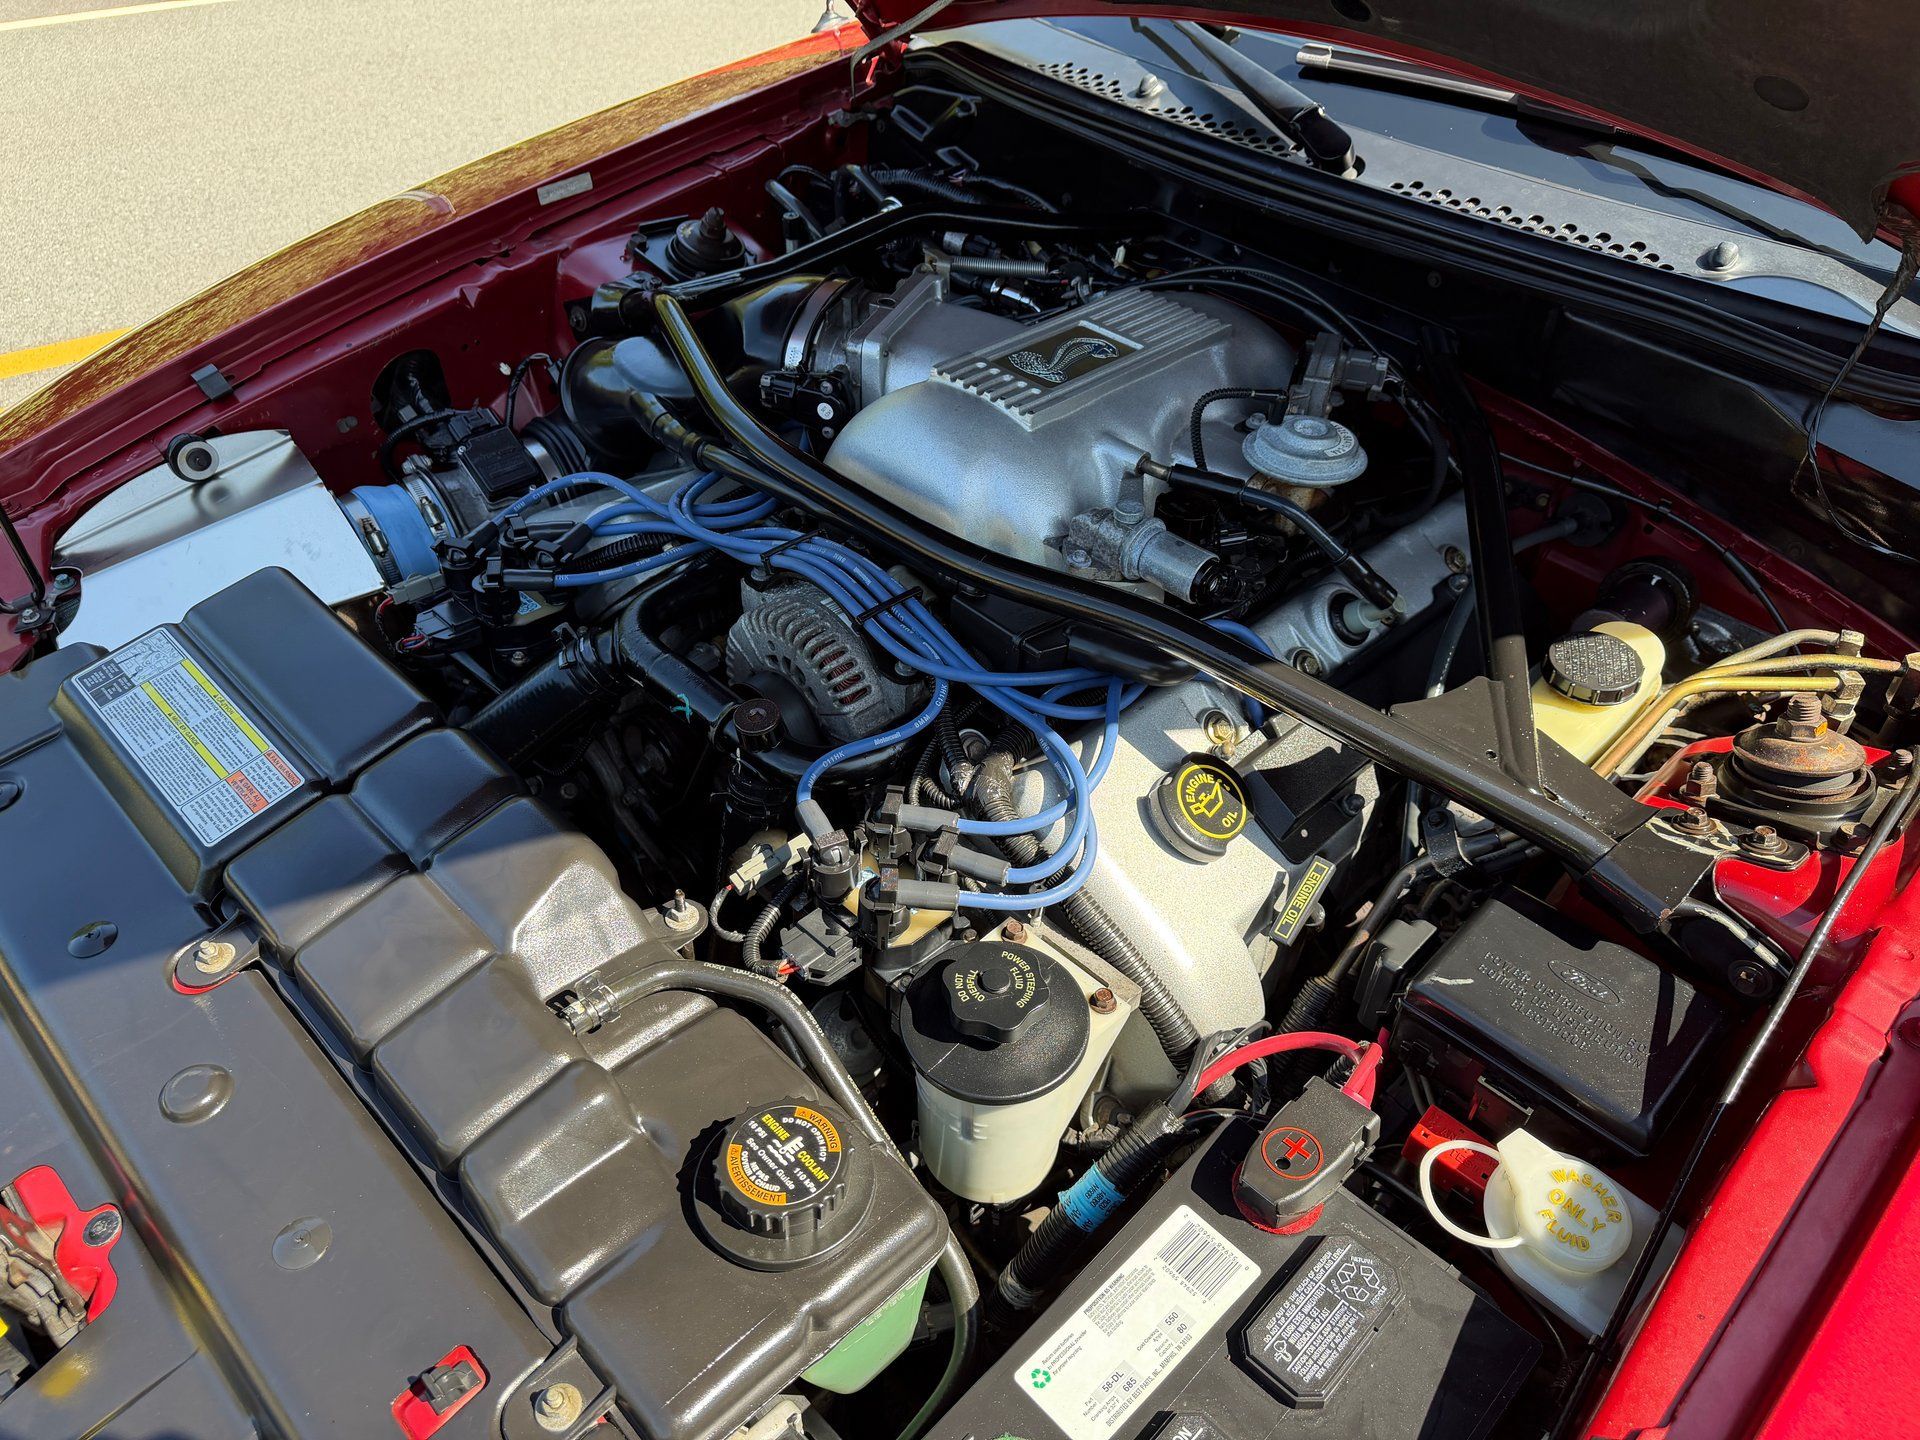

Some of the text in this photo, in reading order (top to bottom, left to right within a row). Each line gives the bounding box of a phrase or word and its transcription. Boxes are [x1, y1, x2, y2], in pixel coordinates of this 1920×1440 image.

[1185, 773, 1214, 802] ENGINE
[1221, 811, 1238, 827] OIL
[1282, 872, 1320, 924] ENGINE OIL
[954, 972, 969, 1002] DO NOT
[966, 969, 985, 1001] OVERFILL
[1001, 950, 1035, 1007] POWER STEERING
[1009, 966, 1023, 989] FLUID
[1560, 965, 1609, 1000] Ford
[1483, 950, 1652, 1057] POWER DISTRIBUTION BO
[1530, 994, 1643, 1068] DE DISTRIBUTION
[748, 1120, 767, 1138] 16 PSI
[761, 1113, 790, 1140] ENGINE
[795, 1119, 811, 1128] NOT
[810, 1125, 824, 1144] OPEN
[808, 1113, 837, 1148] WARNING
[730, 1156, 781, 1201] AVERTISSEMENT
[741, 1150, 752, 1175] OUVRIR
[754, 1178, 780, 1191] CHAUD
[746, 1137, 795, 1189] See Owner Guide
[749, 1162, 769, 1181] NE PAS
[797, 1150, 829, 1182] COOLANT
[793, 1167, 816, 1193] 110 kPa
[1551, 1168, 1621, 1223] WASHER
[1549, 1188, 1606, 1233] ONLY
[1195, 1223, 1215, 1241] 59602
[1539, 1209, 1589, 1251] FLUID
[1217, 1242, 1237, 1260] 52948
[1163, 1264, 1178, 1279] 59602
[1180, 1280, 1196, 1295] 52948
[1274, 1305, 1287, 1318] OUT
[1282, 1298, 1292, 1308] OF
[1288, 1289, 1299, 1301] THE
[1296, 1276, 1310, 1292] REACH
[1307, 1269, 1316, 1279] OF
[1313, 1250, 1331, 1271] CHILDREN
[1163, 1310, 1179, 1326] 550
[1263, 1333, 1272, 1343] DO
[1269, 1323, 1280, 1336] NOT
[1284, 1303, 1297, 1317] KEEP
[1294, 1292, 1306, 1305] VENT
[1281, 1285, 1325, 1338] FLUSH EYES IMMEDIATELY
[1295, 1306, 1330, 1349] MEDICAL HELP FAST
[1175, 1322, 1187, 1334] 80
[1101, 1369, 1124, 1392] 58-DL
[1121, 1376, 1137, 1392] 685
[1106, 1402, 1128, 1425] DISTRIBUTED
[1126, 1396, 1134, 1404] BY
[1131, 1387, 1142, 1399] BEST
